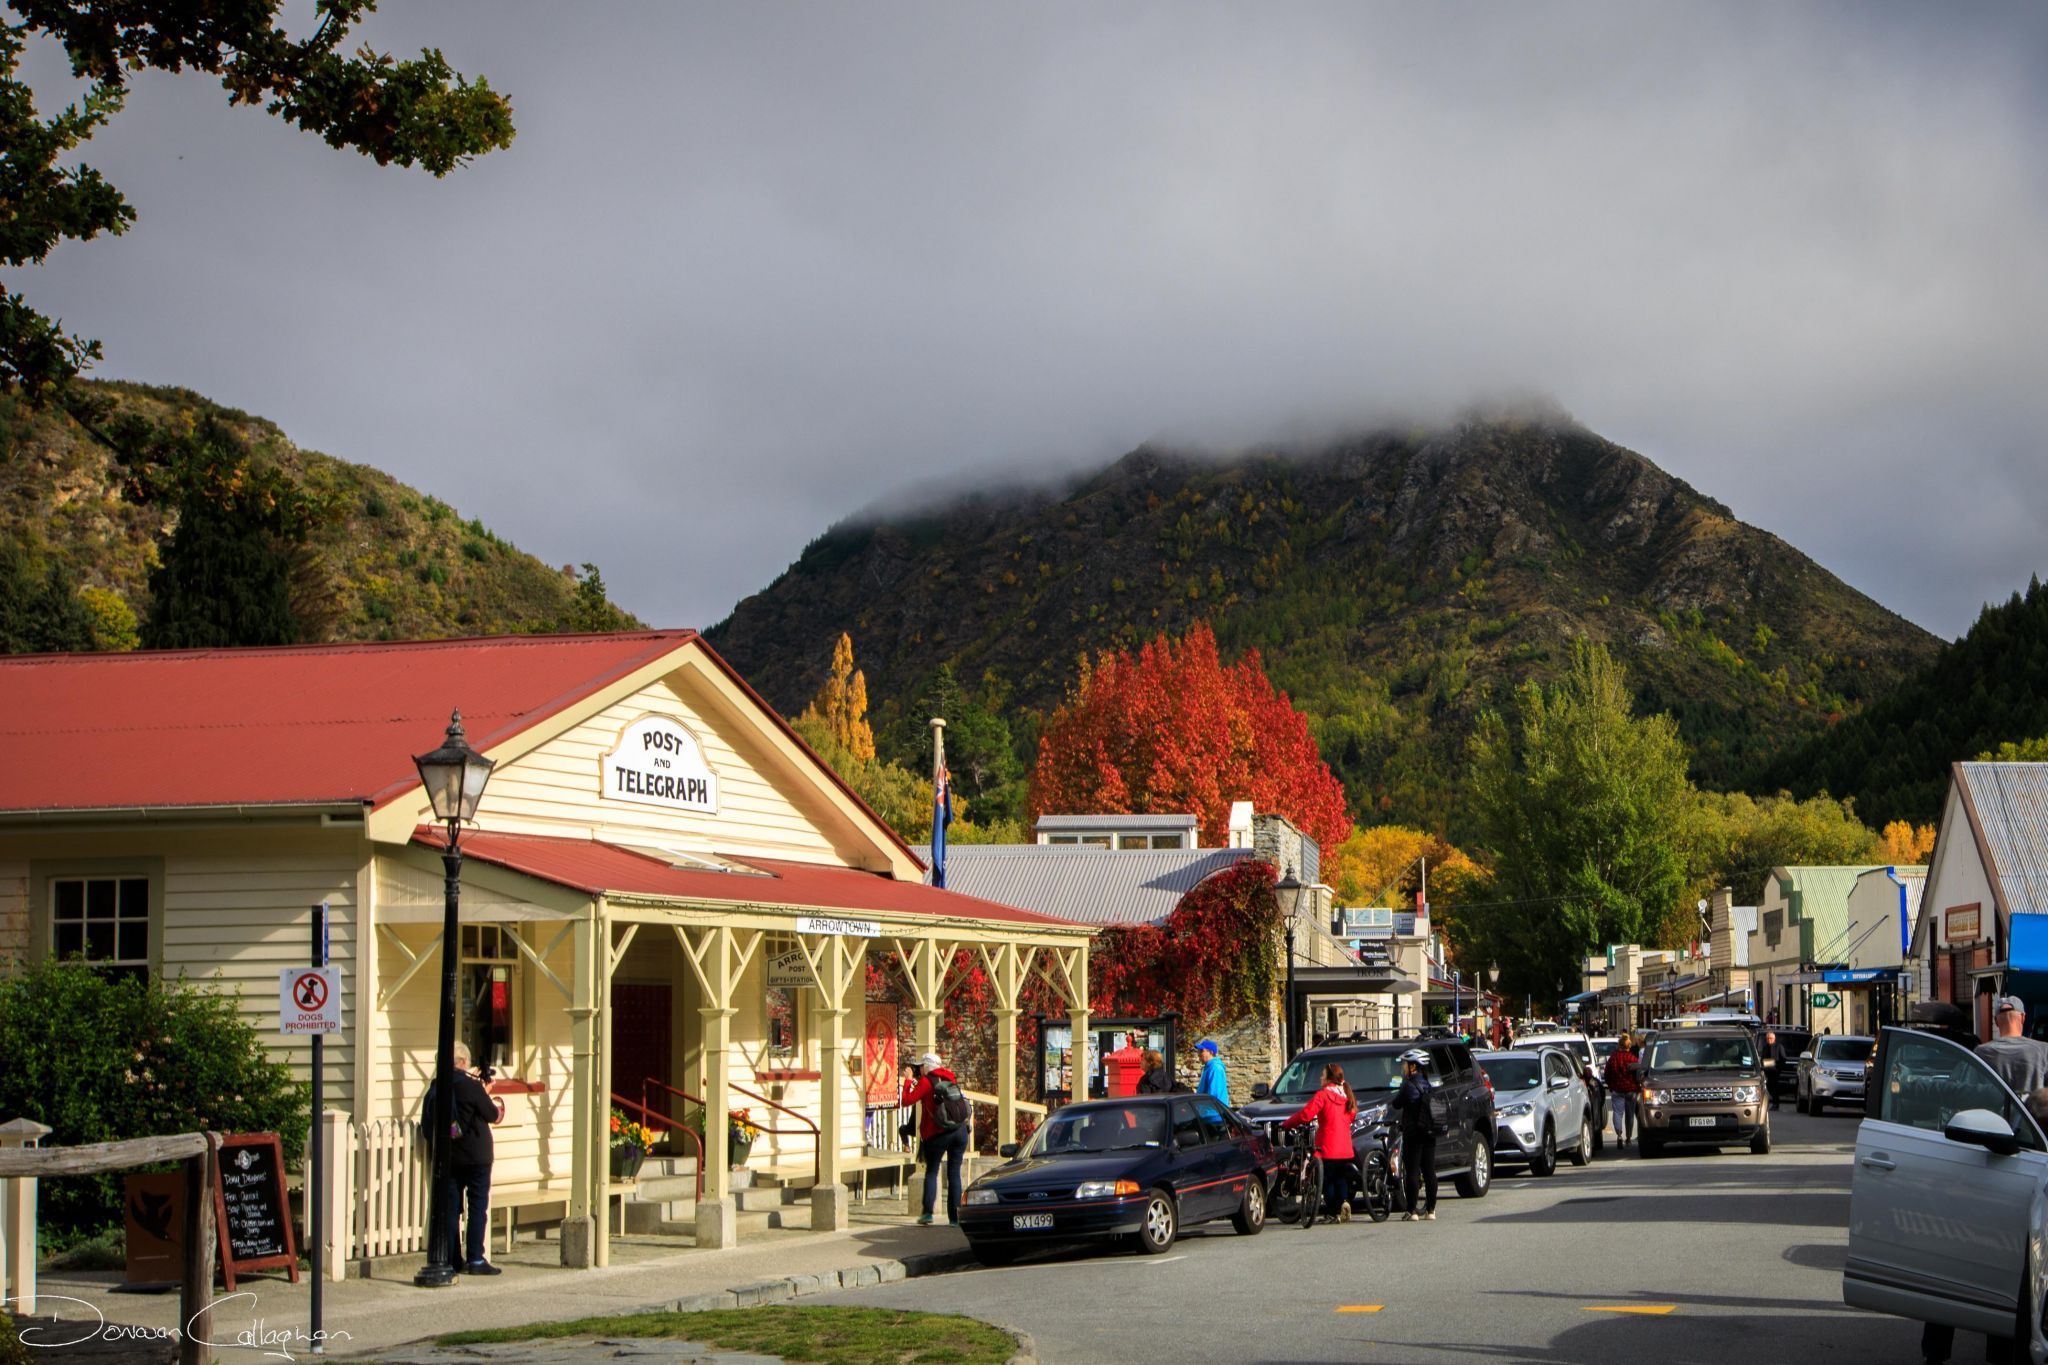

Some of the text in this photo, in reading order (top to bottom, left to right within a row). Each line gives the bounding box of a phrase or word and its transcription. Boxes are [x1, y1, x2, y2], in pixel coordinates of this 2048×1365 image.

[642, 730, 683, 756] POST
[653, 758, 671, 769] AND
[616, 766, 708, 804] TELEGRAPH
[808, 919, 871, 933] ARROWTOWN
[788, 965, 806, 973] POST
[298, 1013, 323, 1022] DOGS
[285, 1021, 336, 1030] PROHIBITED
[1014, 1214, 1052, 1228] SX1499
